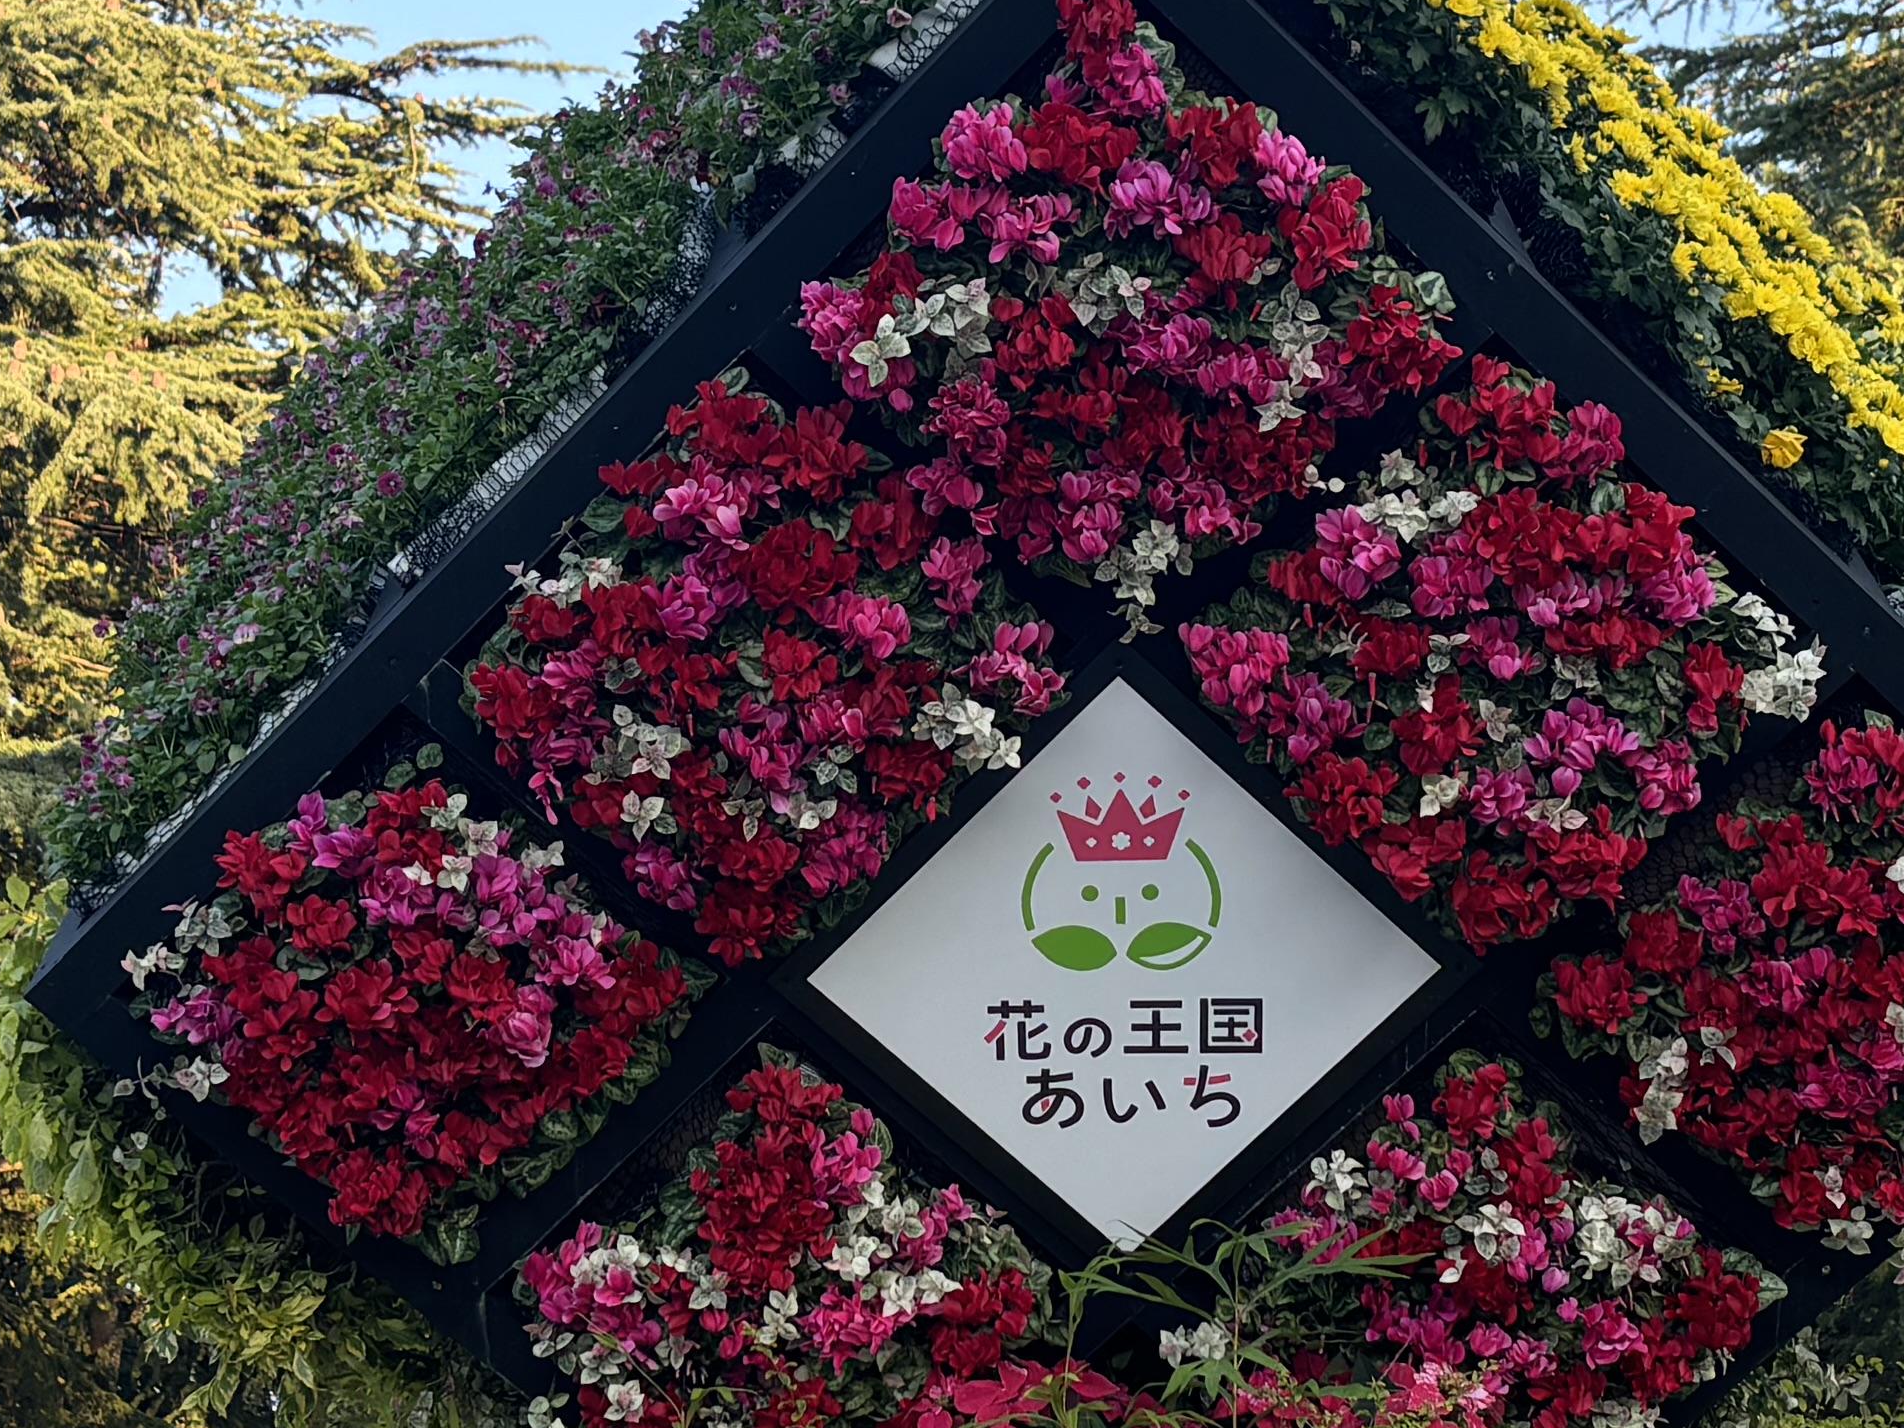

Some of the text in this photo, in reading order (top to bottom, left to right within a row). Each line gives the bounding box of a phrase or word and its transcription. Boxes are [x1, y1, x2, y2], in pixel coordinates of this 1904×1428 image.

[984, 997, 1263, 1061] 花の王国
[1021, 1064, 1241, 1128] あいち
